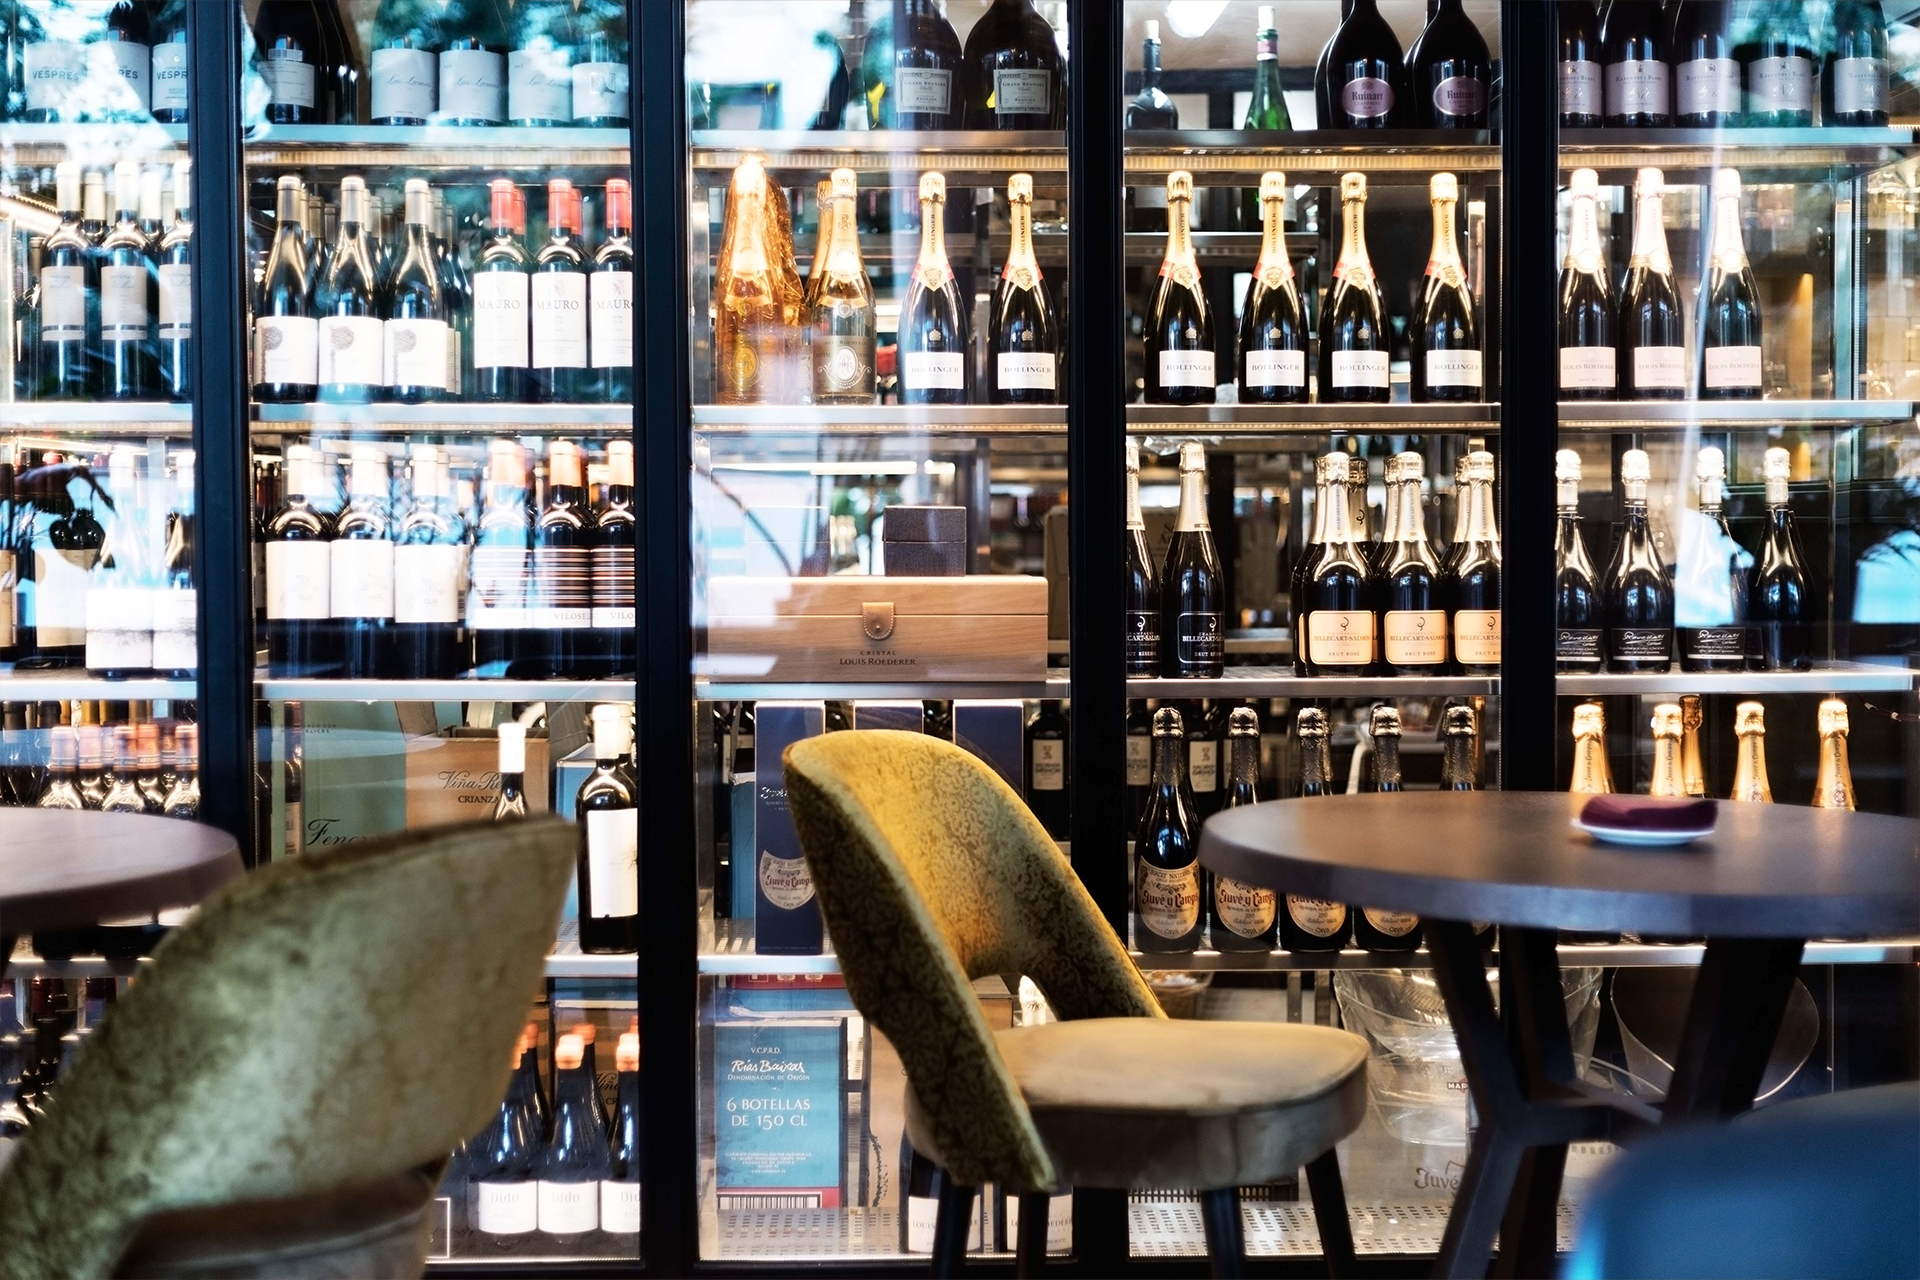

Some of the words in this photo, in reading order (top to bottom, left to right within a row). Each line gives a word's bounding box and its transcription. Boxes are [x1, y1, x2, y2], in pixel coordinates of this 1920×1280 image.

[32, 69, 79, 81] VESPRES
[1352, 91, 1383, 101] Ruinart
[1447, 90, 1478, 99] Ruinart
[478, 299, 521, 310] MAURO
[536, 300, 579, 310] MAURO
[1339, 364, 1386, 372] BOLLINGER
[1434, 363, 1480, 371] BOLLINGER
[840, 658, 866, 666] LOUIS
[868, 657, 916, 665] ROEDERER
[438, 770, 478, 790] Viña
[1149, 870, 1167, 878] BRUT
[765, 874, 785, 886] Juvé
[785, 879, 790, 887] y
[1142, 890, 1164, 905] Juvé
[1164, 896, 1173, 908] y
[1175, 892, 1199, 908] Camps
[1219, 889, 1242, 905] Juvé
[1242, 895, 1251, 908] y
[1252, 892, 1275, 908] Camps
[731, 1059, 758, 1073] Rías
[759, 1060, 806, 1074] Baixas
[727, 1073, 775, 1081] DENOMINACIÓN
[726, 1097, 737, 1112] 6
[742, 1099, 810, 1110] BOTELLAS
[731, 1115, 749, 1126] DE
[757, 1115, 784, 1130] 150
[790, 1115, 808, 1126] CL
[1414, 1167, 1459, 1189] Juvé
[490, 1192, 519, 1203] Dido
[551, 1191, 580, 1203] Dido
[912, 1220, 936, 1229] LOUIS
